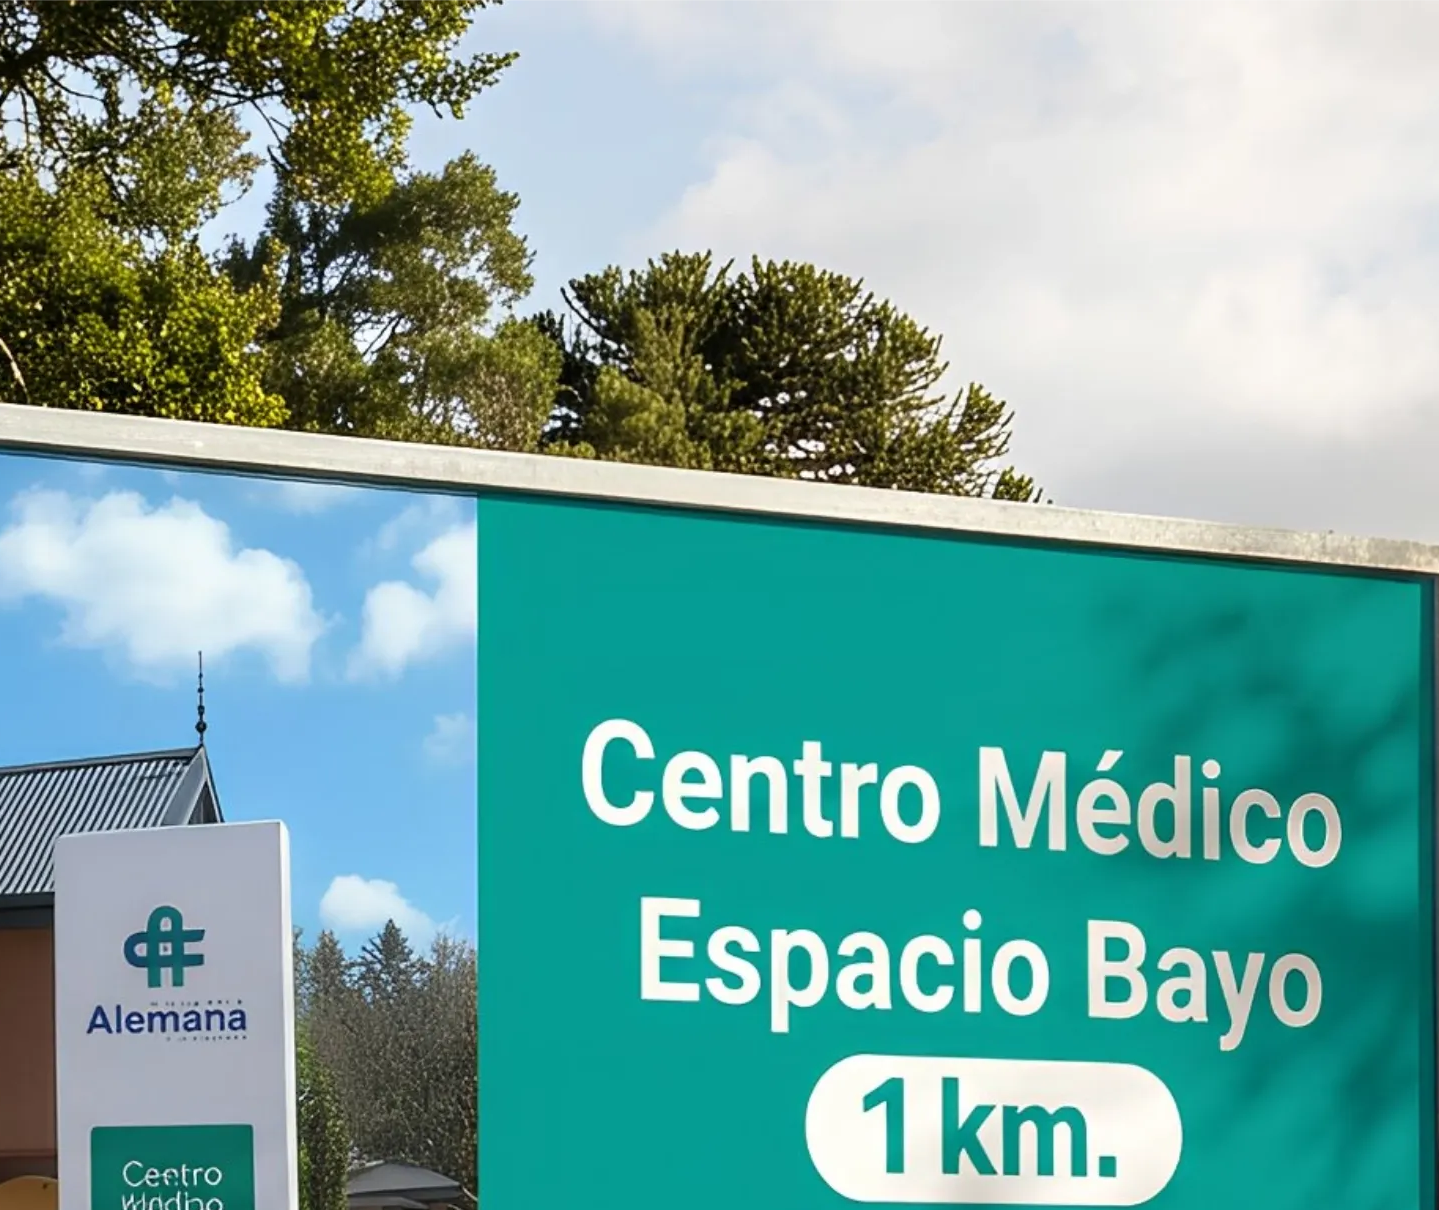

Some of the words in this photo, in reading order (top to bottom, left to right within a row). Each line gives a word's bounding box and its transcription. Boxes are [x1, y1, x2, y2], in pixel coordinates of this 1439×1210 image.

[581, 718, 941, 844] Centro
[978, 746, 1343, 868] Médico
[86, 1004, 247, 1034] Alemana
[640, 896, 1050, 1033] Espacio
[1087, 919, 1322, 1052] Bayo
[123, 1160, 222, 1187] Centro
[861, 1076, 906, 1174] 1
[941, 1076, 1118, 1178] km.
